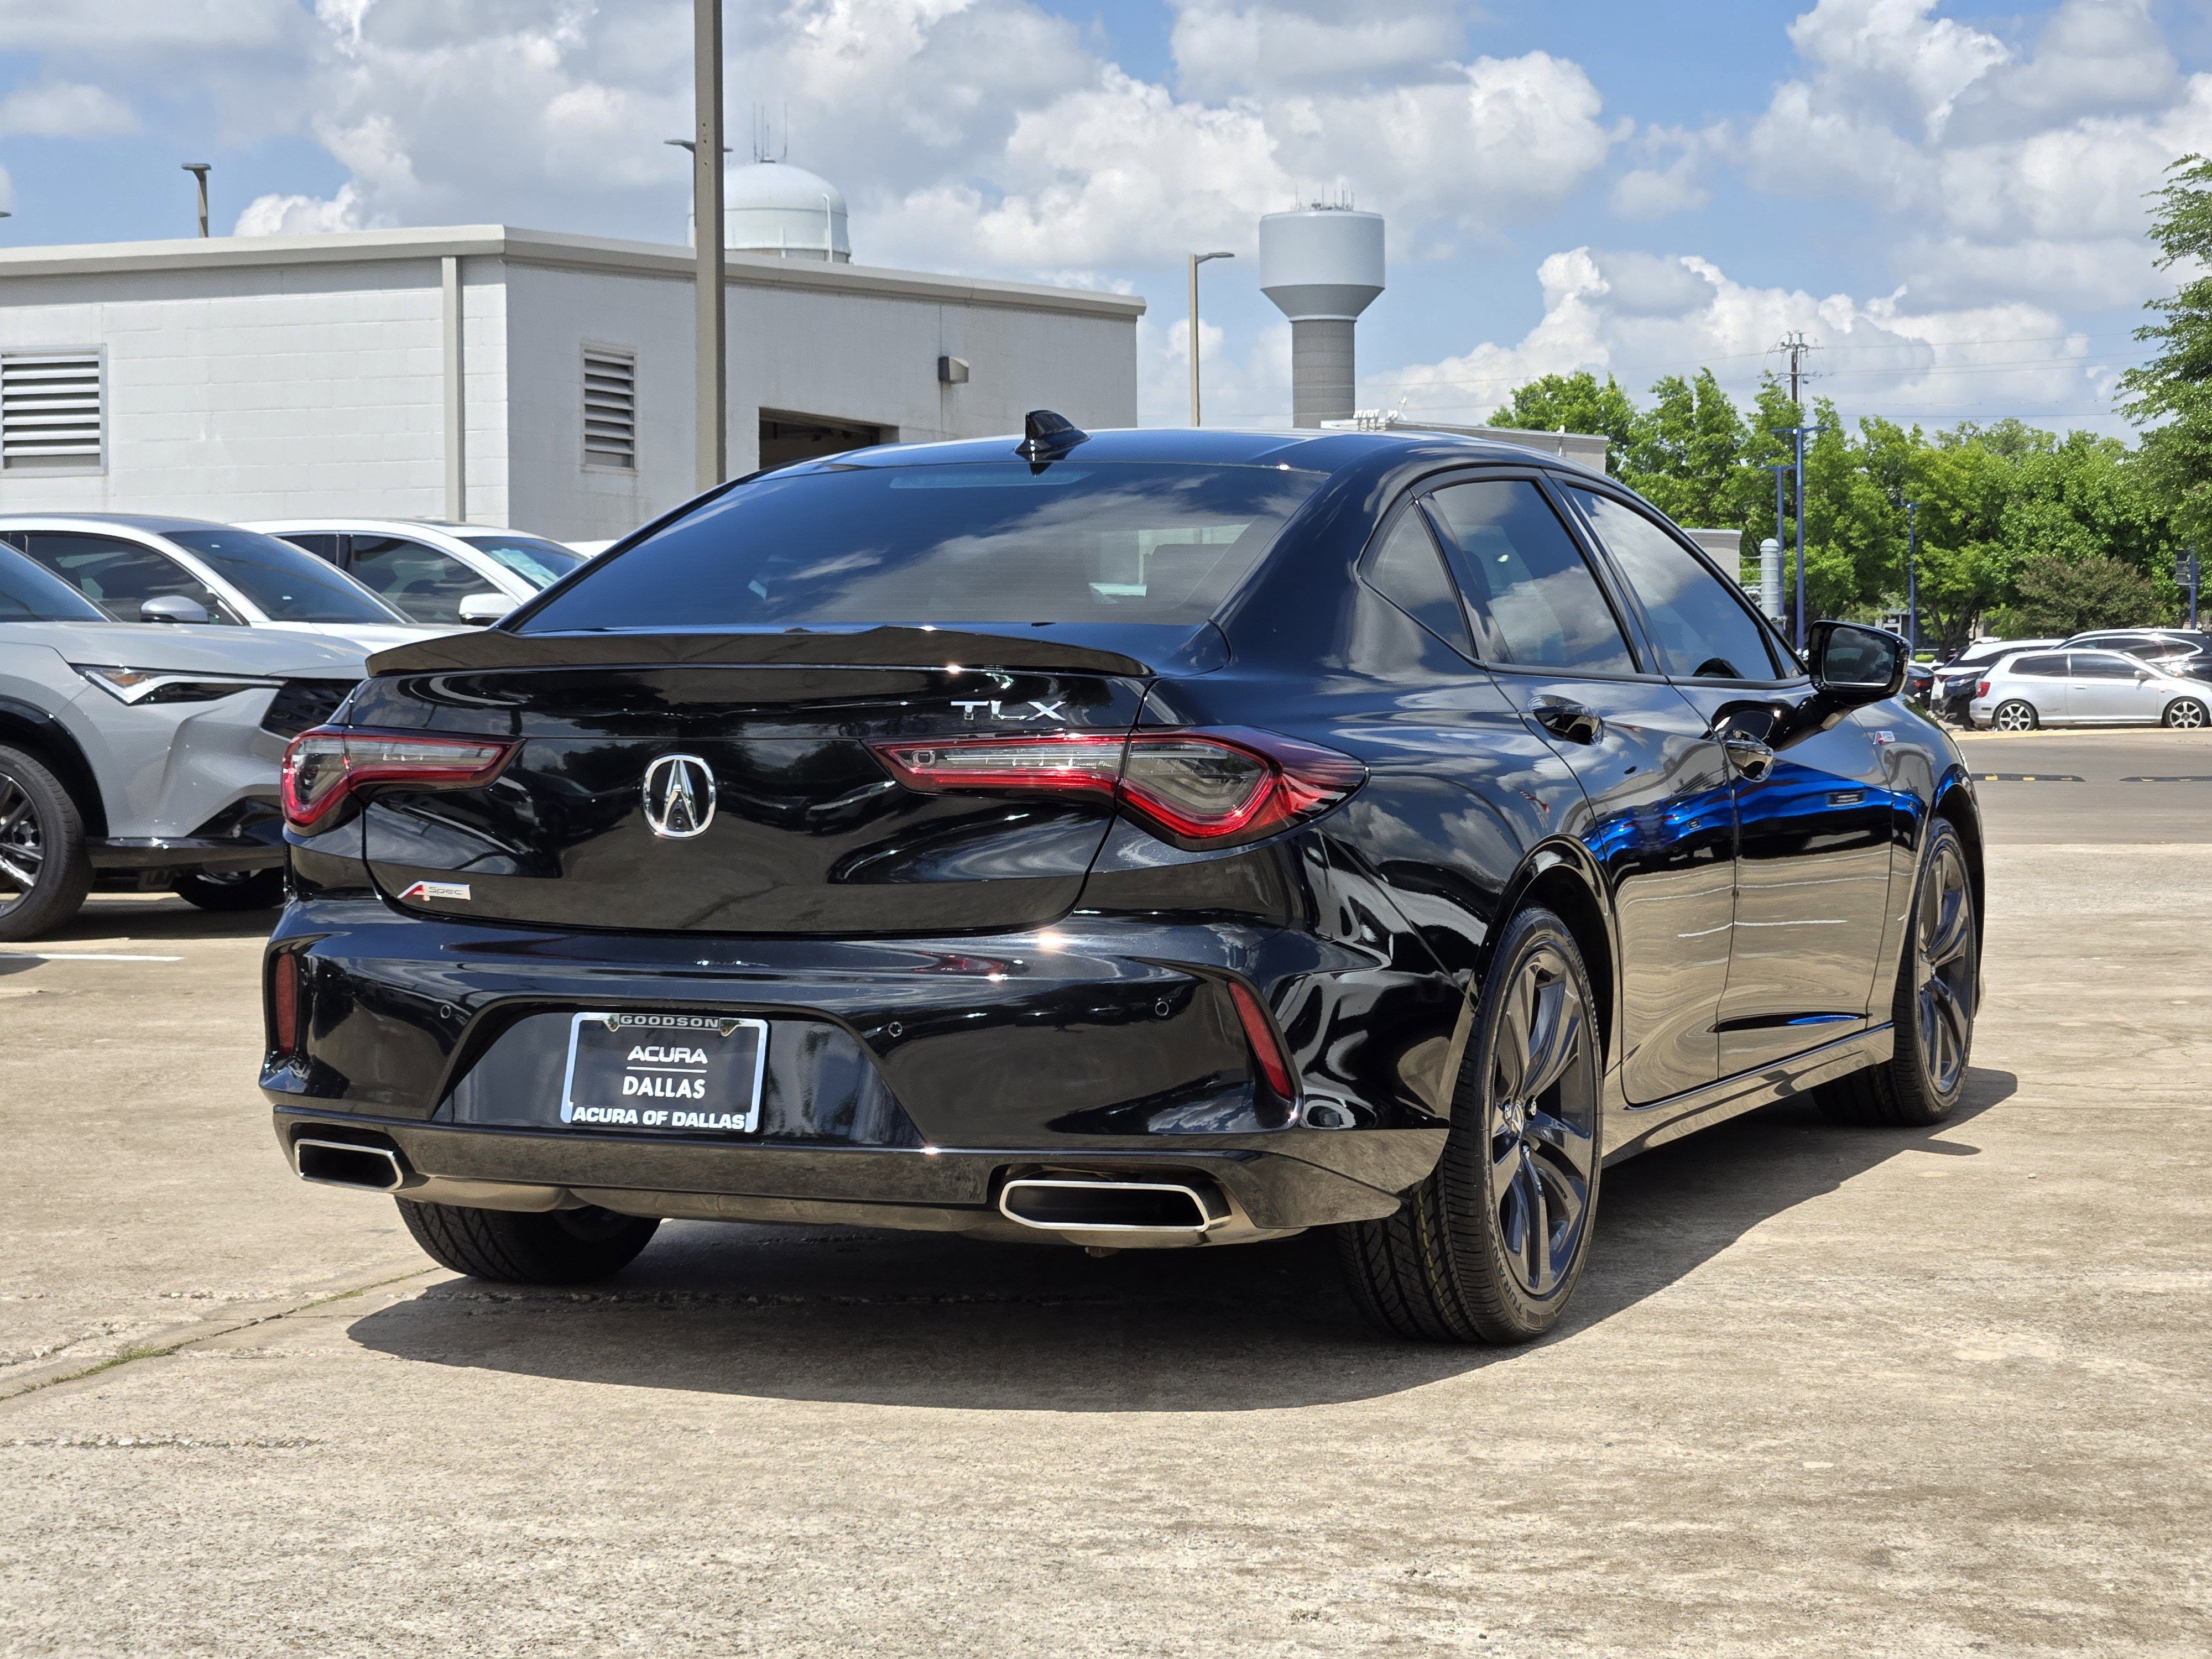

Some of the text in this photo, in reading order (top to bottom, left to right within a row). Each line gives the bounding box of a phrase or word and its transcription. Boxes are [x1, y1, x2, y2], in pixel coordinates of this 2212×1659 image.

[951, 700, 1066, 721] TLX
[620, 1015, 719, 1029] GOODSON
[627, 1045, 708, 1064] ACURA
[622, 1076, 706, 1099] DALLAS
[572, 1107, 745, 1130] ACURA OF DALLAS
[1487, 1207, 1523, 1316] TURANZA
